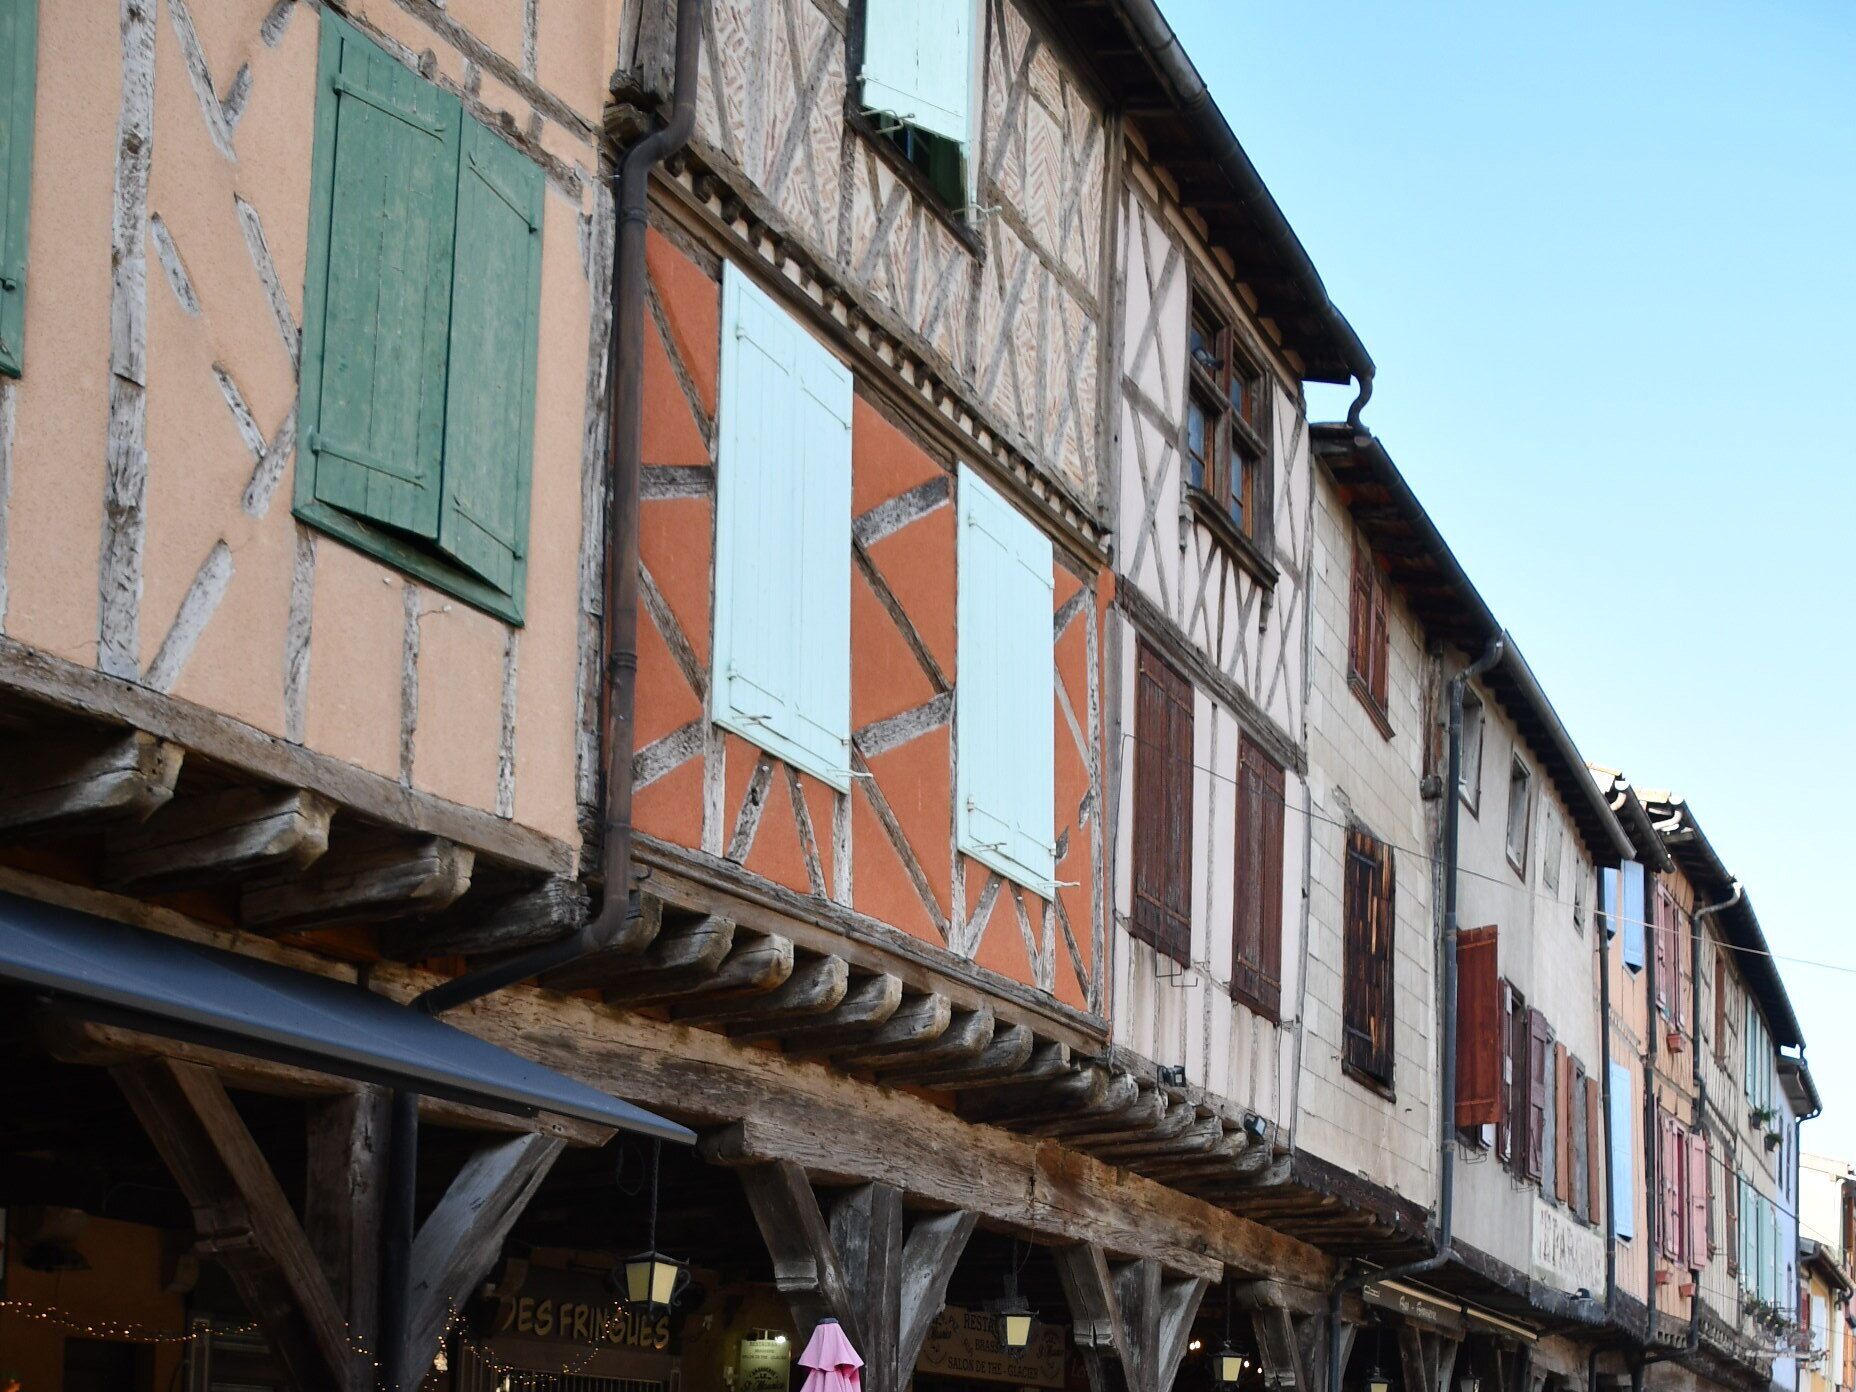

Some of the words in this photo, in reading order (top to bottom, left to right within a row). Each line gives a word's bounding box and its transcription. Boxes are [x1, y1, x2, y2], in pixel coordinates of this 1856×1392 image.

[560, 1303, 671, 1350] FRINGUES
[948, 1356, 975, 1372] SALON
[976, 1361, 986, 1373] DE
[1008, 1364, 1039, 1379] GLACIER
